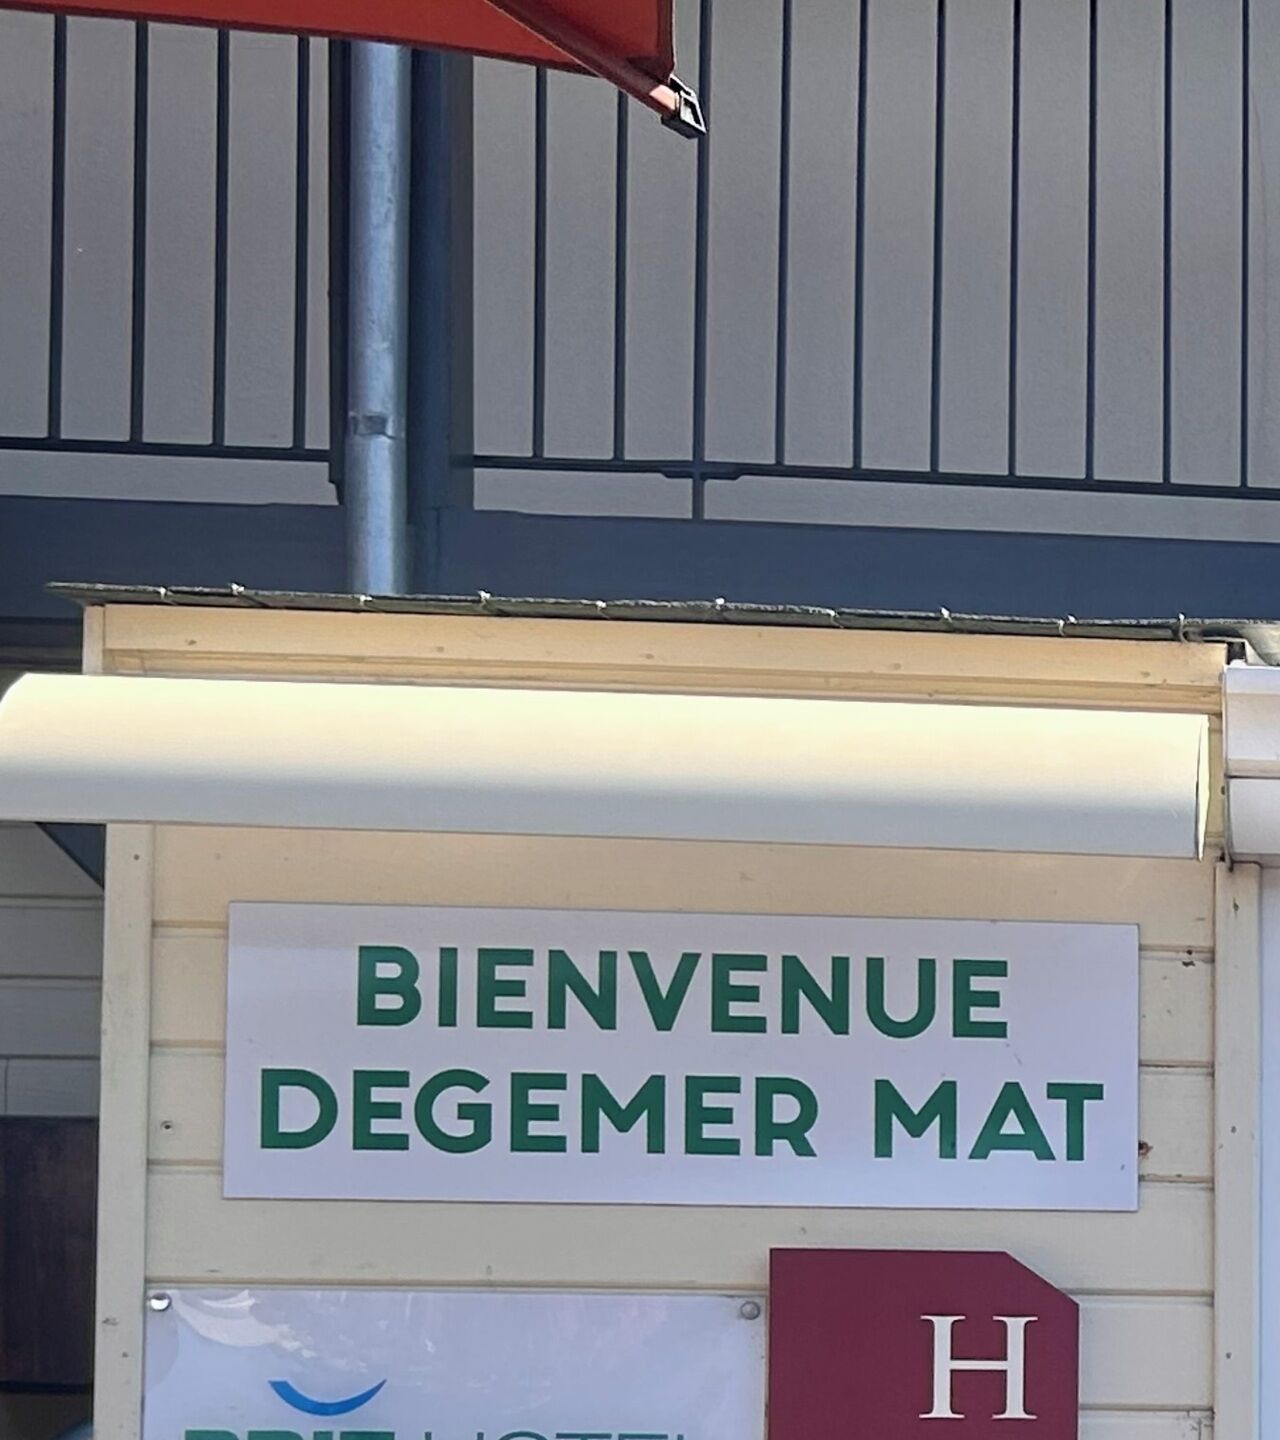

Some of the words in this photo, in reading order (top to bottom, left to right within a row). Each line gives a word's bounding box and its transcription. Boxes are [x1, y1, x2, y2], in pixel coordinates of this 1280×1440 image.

[356, 945, 1009, 1039] BIENVENUE
[260, 1068, 818, 1158] DEGEMER
[874, 1078, 1104, 1161] MAT
[919, 1315, 1037, 1420] H
